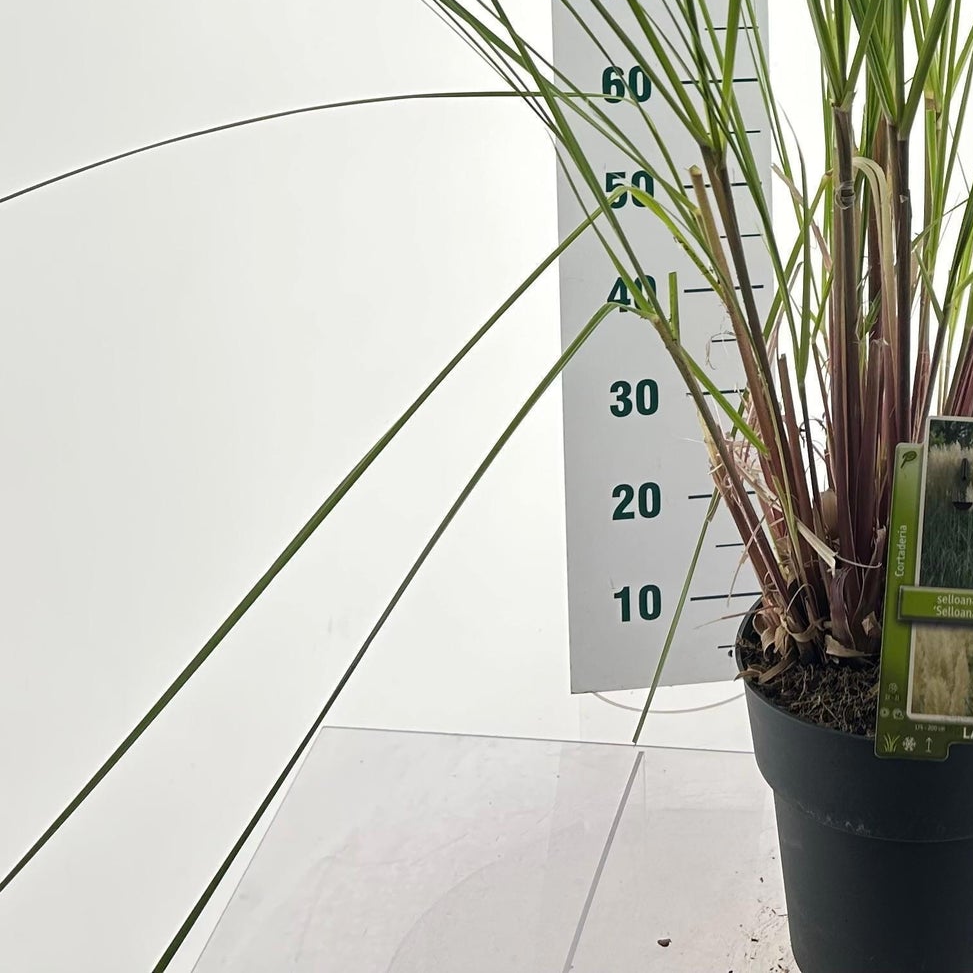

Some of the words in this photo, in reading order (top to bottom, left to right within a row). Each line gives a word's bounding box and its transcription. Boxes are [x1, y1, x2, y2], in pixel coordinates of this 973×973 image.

[602, 65, 652, 104] 60
[606, 170, 654, 209] 50
[609, 379, 659, 418] 30
[612, 482, 661, 521] 20
[894, 524, 908, 577] Cortaderia
[613, 584, 662, 622] 10
